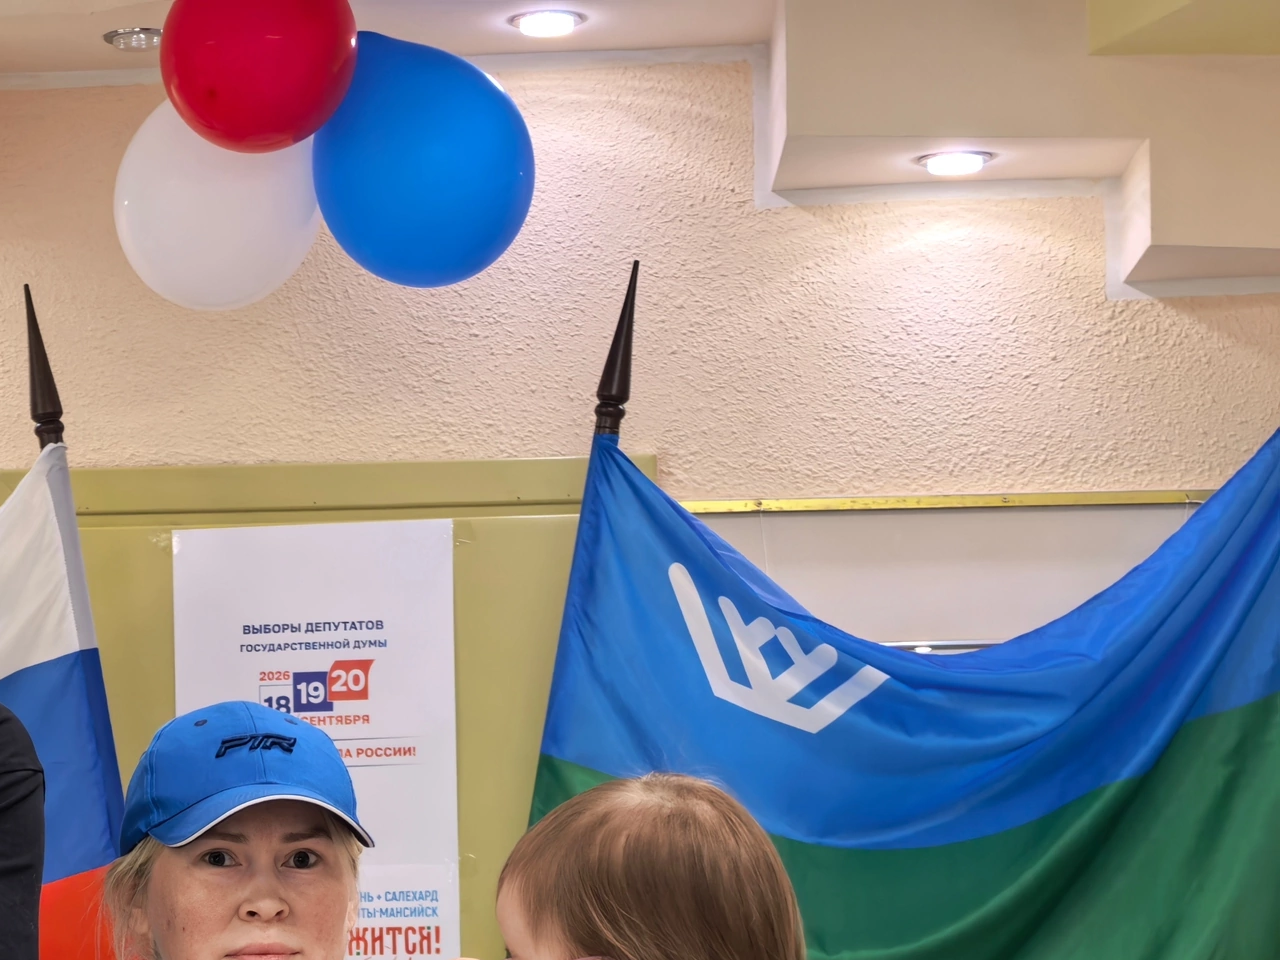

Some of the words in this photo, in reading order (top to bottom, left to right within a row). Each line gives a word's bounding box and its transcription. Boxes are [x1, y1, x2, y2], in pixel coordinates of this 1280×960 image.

[243, 623, 301, 635] ВЫБОРЫ
[304, 620, 384, 634] ДЕПУТАТОВ
[240, 639, 350, 653] ГОСУДАРСТВЕННОЙ
[352, 639, 387, 650] ДУМЫ
[259, 671, 291, 682] 2026
[263, 695, 291, 714] 18
[296, 681, 326, 704] 19
[331, 669, 366, 692] 20
[303, 714, 370, 726] СЕНТЯБРЯ
[339, 748, 353, 758] ЛА
[356, 746, 417, 758] РОССИИ!
[360, 891, 374, 903] НЬ
[384, 889, 439, 903] САЛЕХАРД
[358, 904, 439, 918] ТЫ-МАНСИЙСК
[348, 926, 441, 956] ЖИТСЯ!
